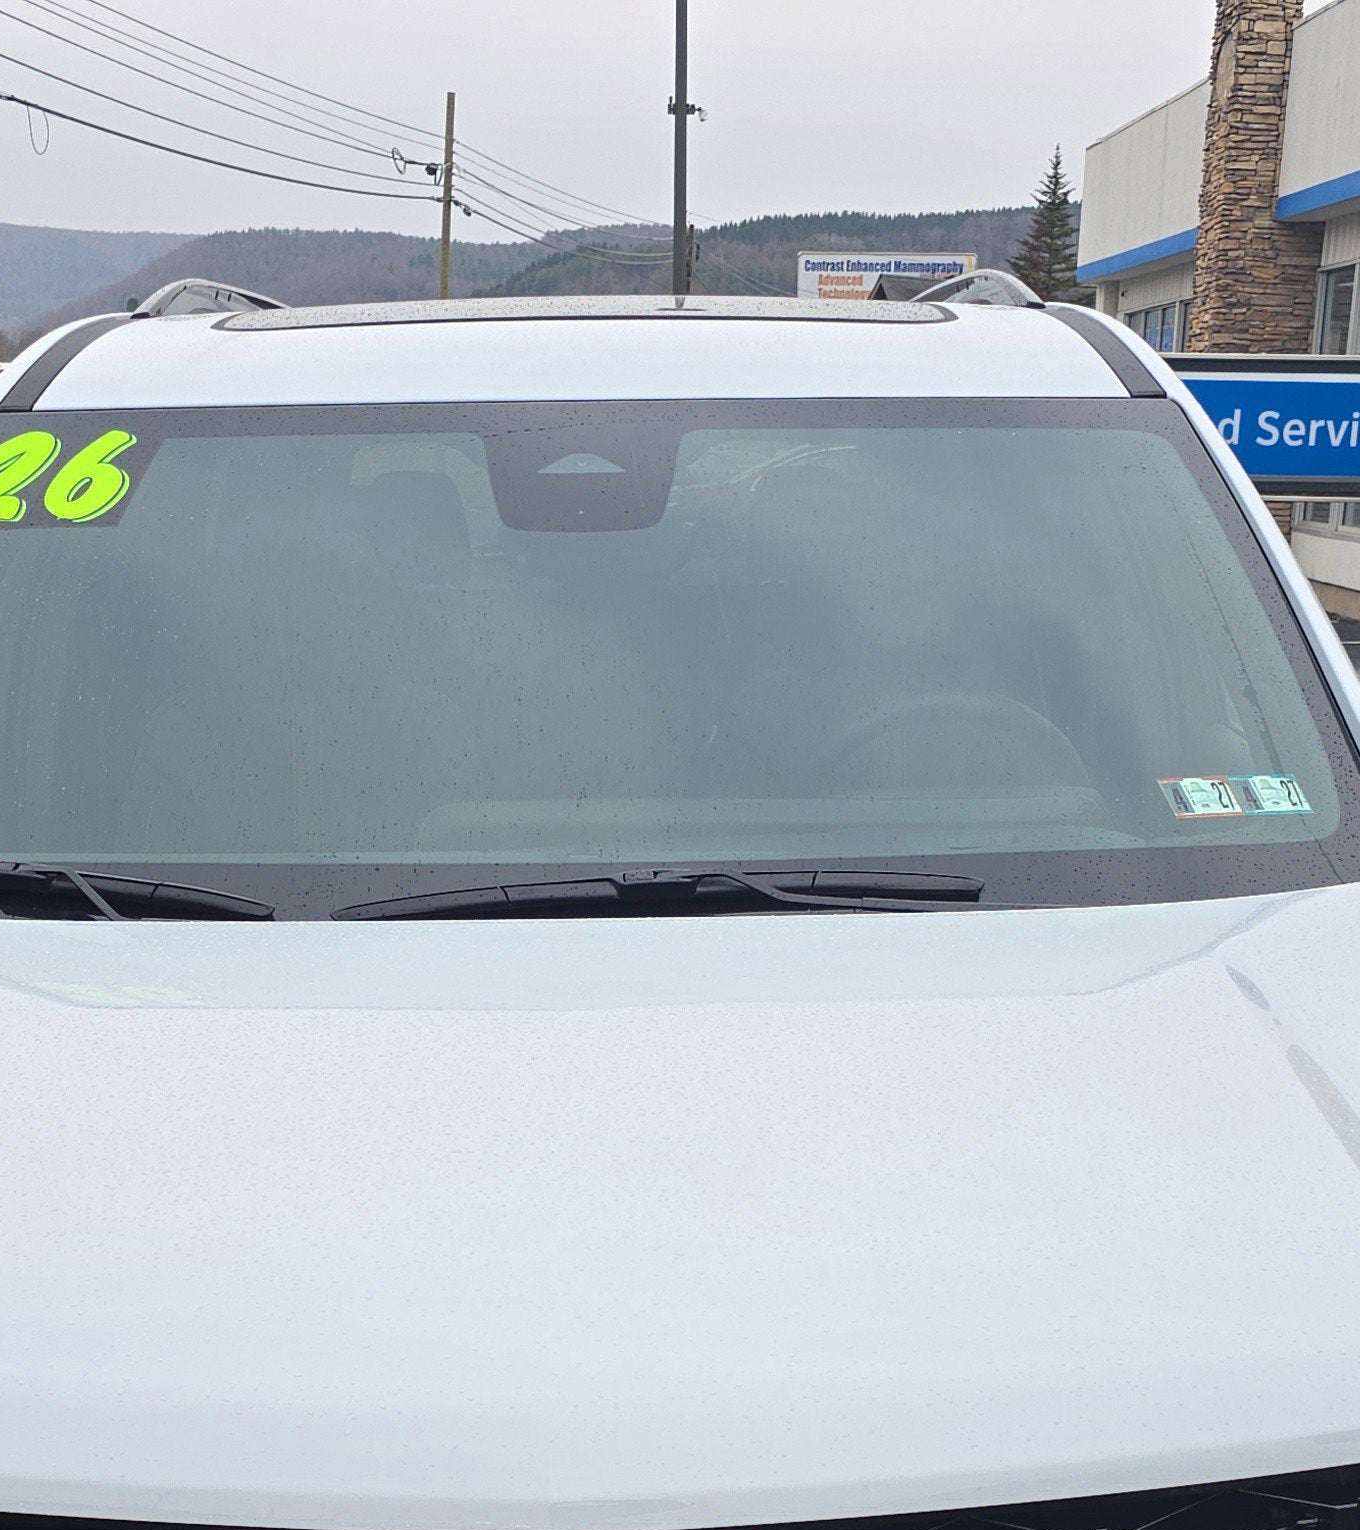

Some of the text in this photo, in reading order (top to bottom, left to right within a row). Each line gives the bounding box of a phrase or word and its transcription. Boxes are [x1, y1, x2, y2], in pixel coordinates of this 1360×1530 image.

[804, 259, 965, 274] Contrast Enhanced Mammography
[817, 274, 864, 286] Advanced
[1210, 781, 1235, 810] 27
[1279, 779, 1304, 808] 27
